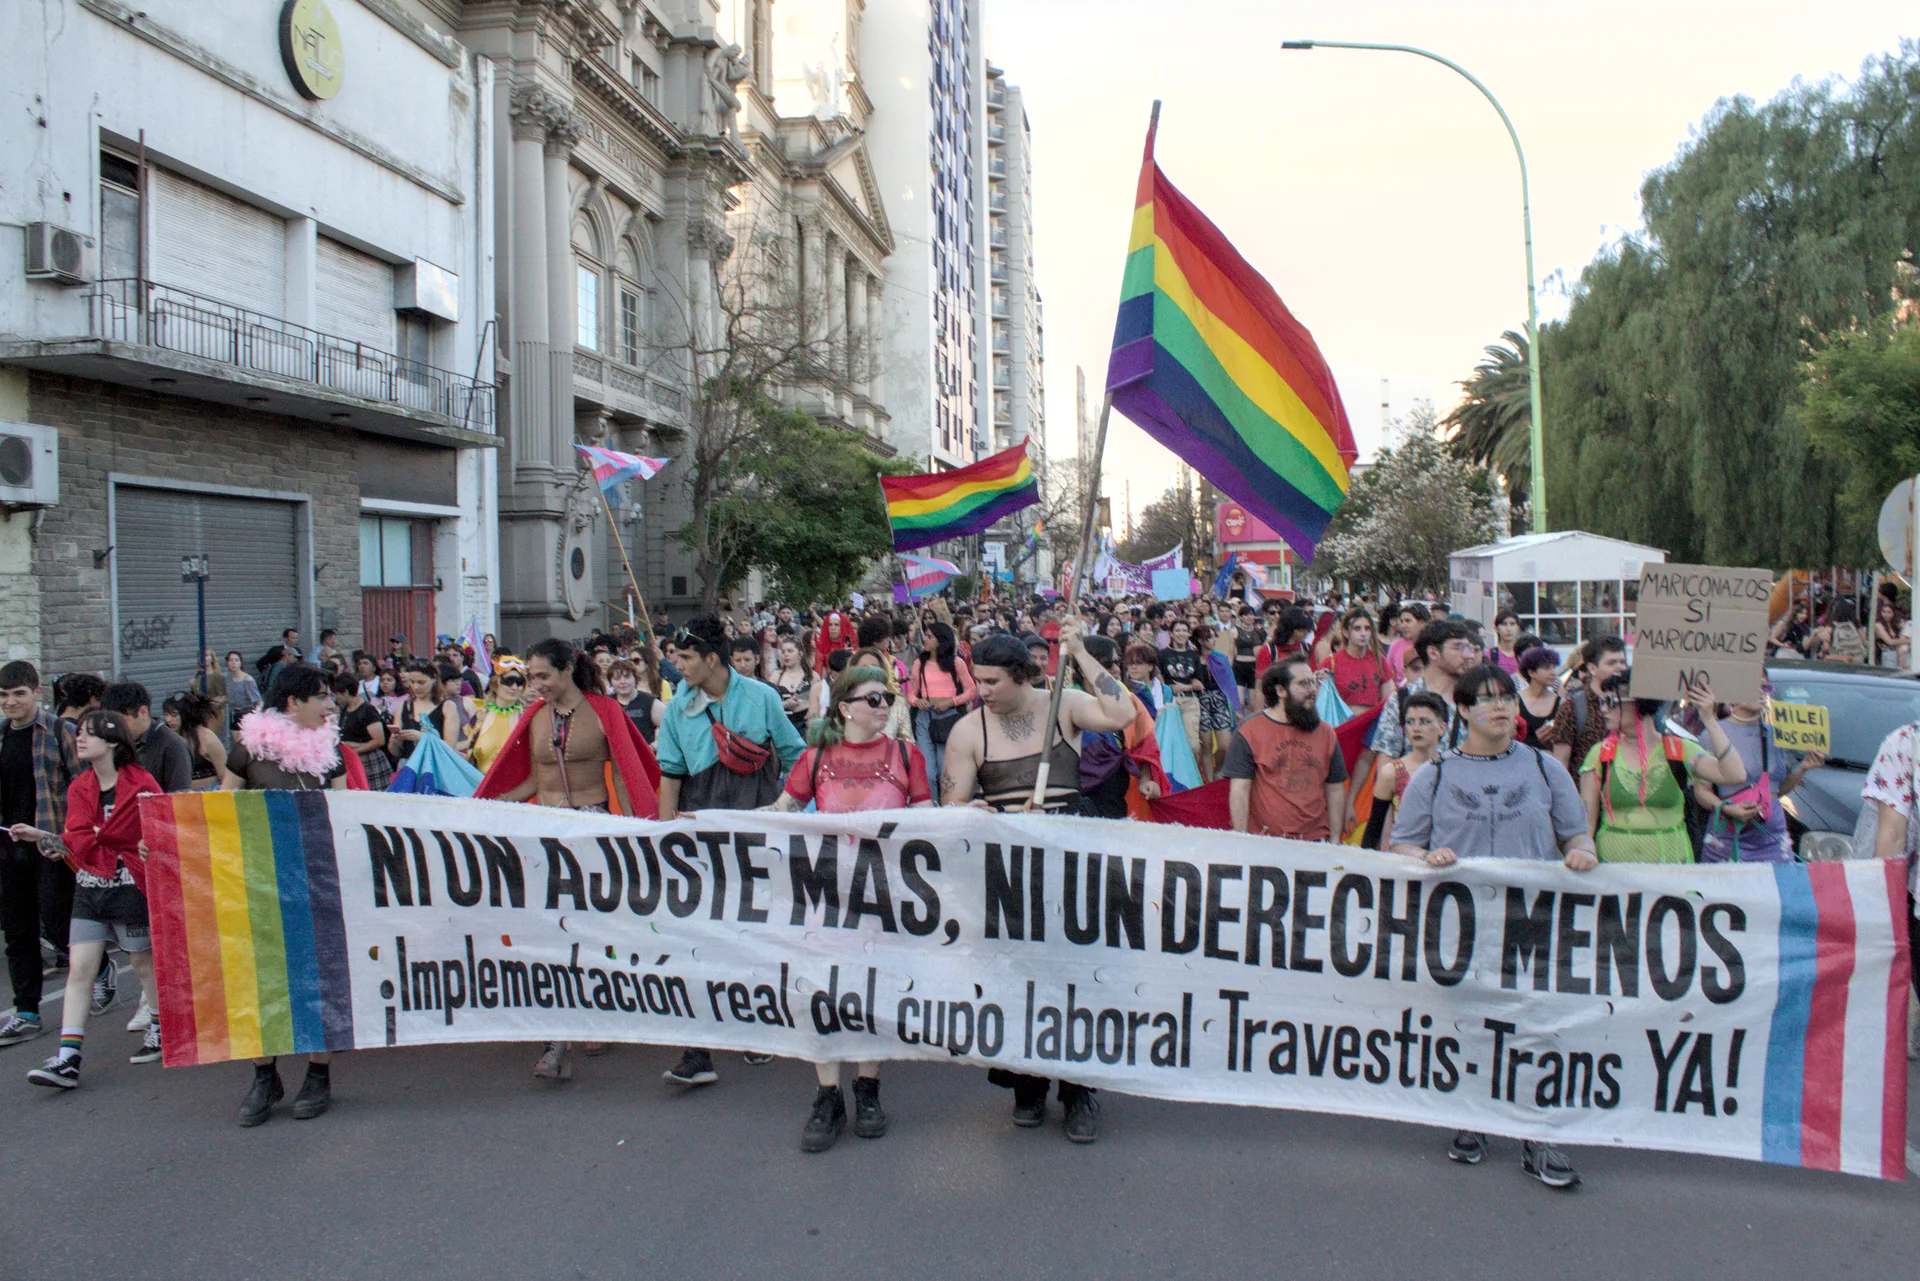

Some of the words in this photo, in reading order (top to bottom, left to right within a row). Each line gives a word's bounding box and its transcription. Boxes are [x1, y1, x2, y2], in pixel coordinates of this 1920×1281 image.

[1640, 572, 1770, 602] MARICONAZOS
[1683, 598, 1711, 623] SI
[1636, 628, 1758, 654] MARICONAZIS
[1678, 667, 1711, 692] NO
[1774, 727, 1798, 745] NOS
[361, 824, 431, 908] NI
[431, 829, 525, 910] UN
[545, 832, 771, 924] AJUSTE
[789, 822, 960, 945] MÁS,
[985, 843, 1044, 942] NI
[1063, 851, 1145, 951] UN
[1161, 860, 1476, 987] DERECHO
[1501, 886, 1747, 1004] MENOS
[706, 961, 795, 1028] real
[811, 965, 876, 1036] del
[896, 995, 1004, 1057] cupo
[1024, 981, 1192, 1068] laboral
